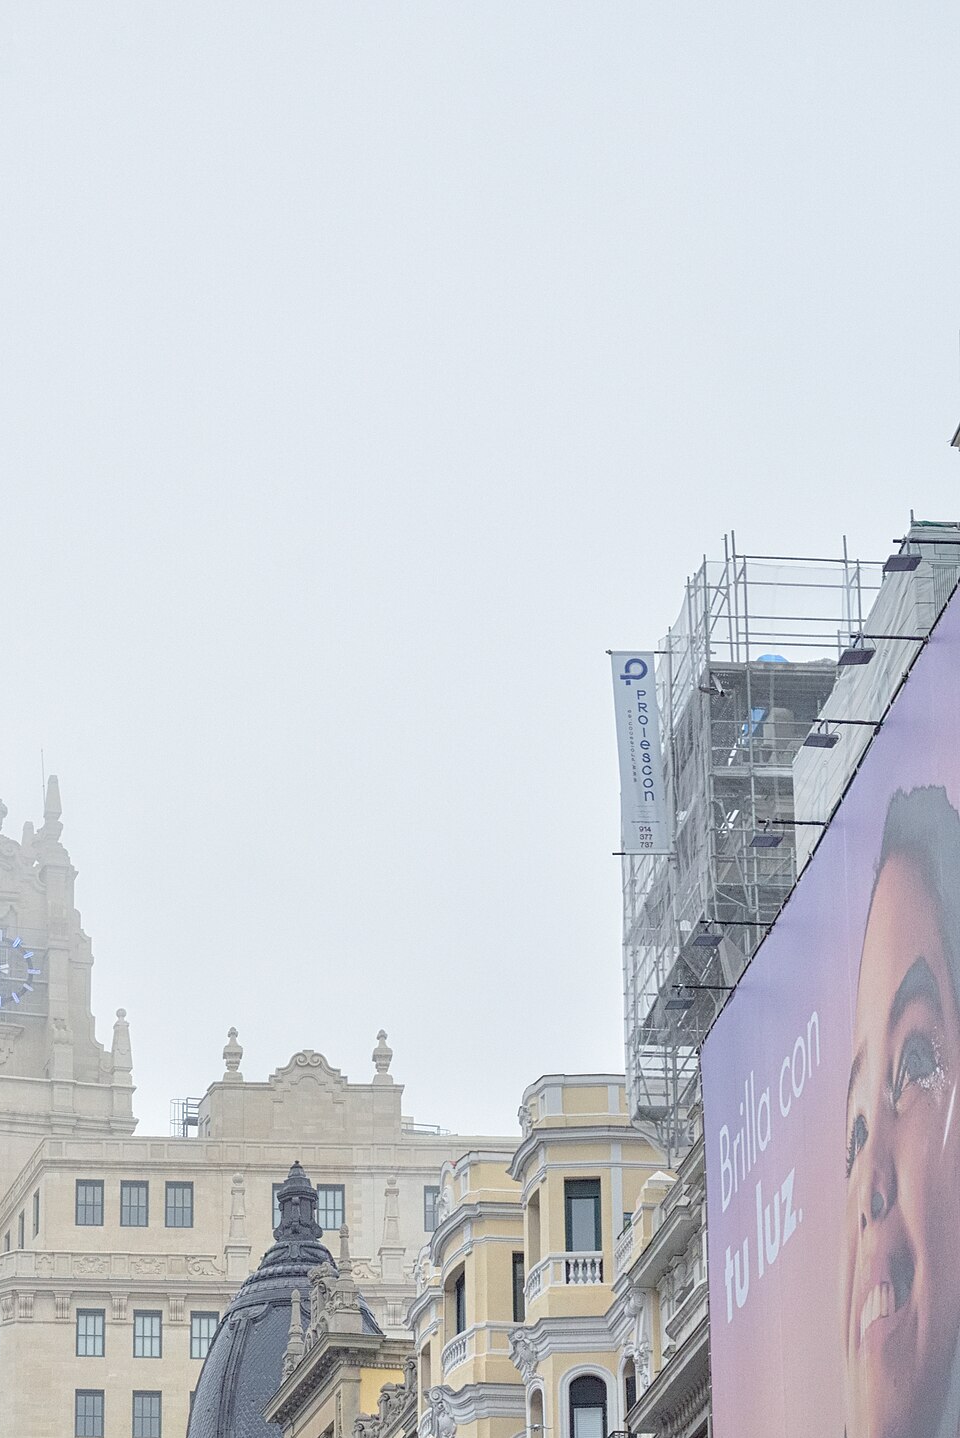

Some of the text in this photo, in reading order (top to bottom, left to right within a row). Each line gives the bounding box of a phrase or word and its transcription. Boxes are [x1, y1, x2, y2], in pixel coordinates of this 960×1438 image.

[719, 1011, 820, 1213] Brilla con
[725, 1167, 803, 1324] tu luz.
